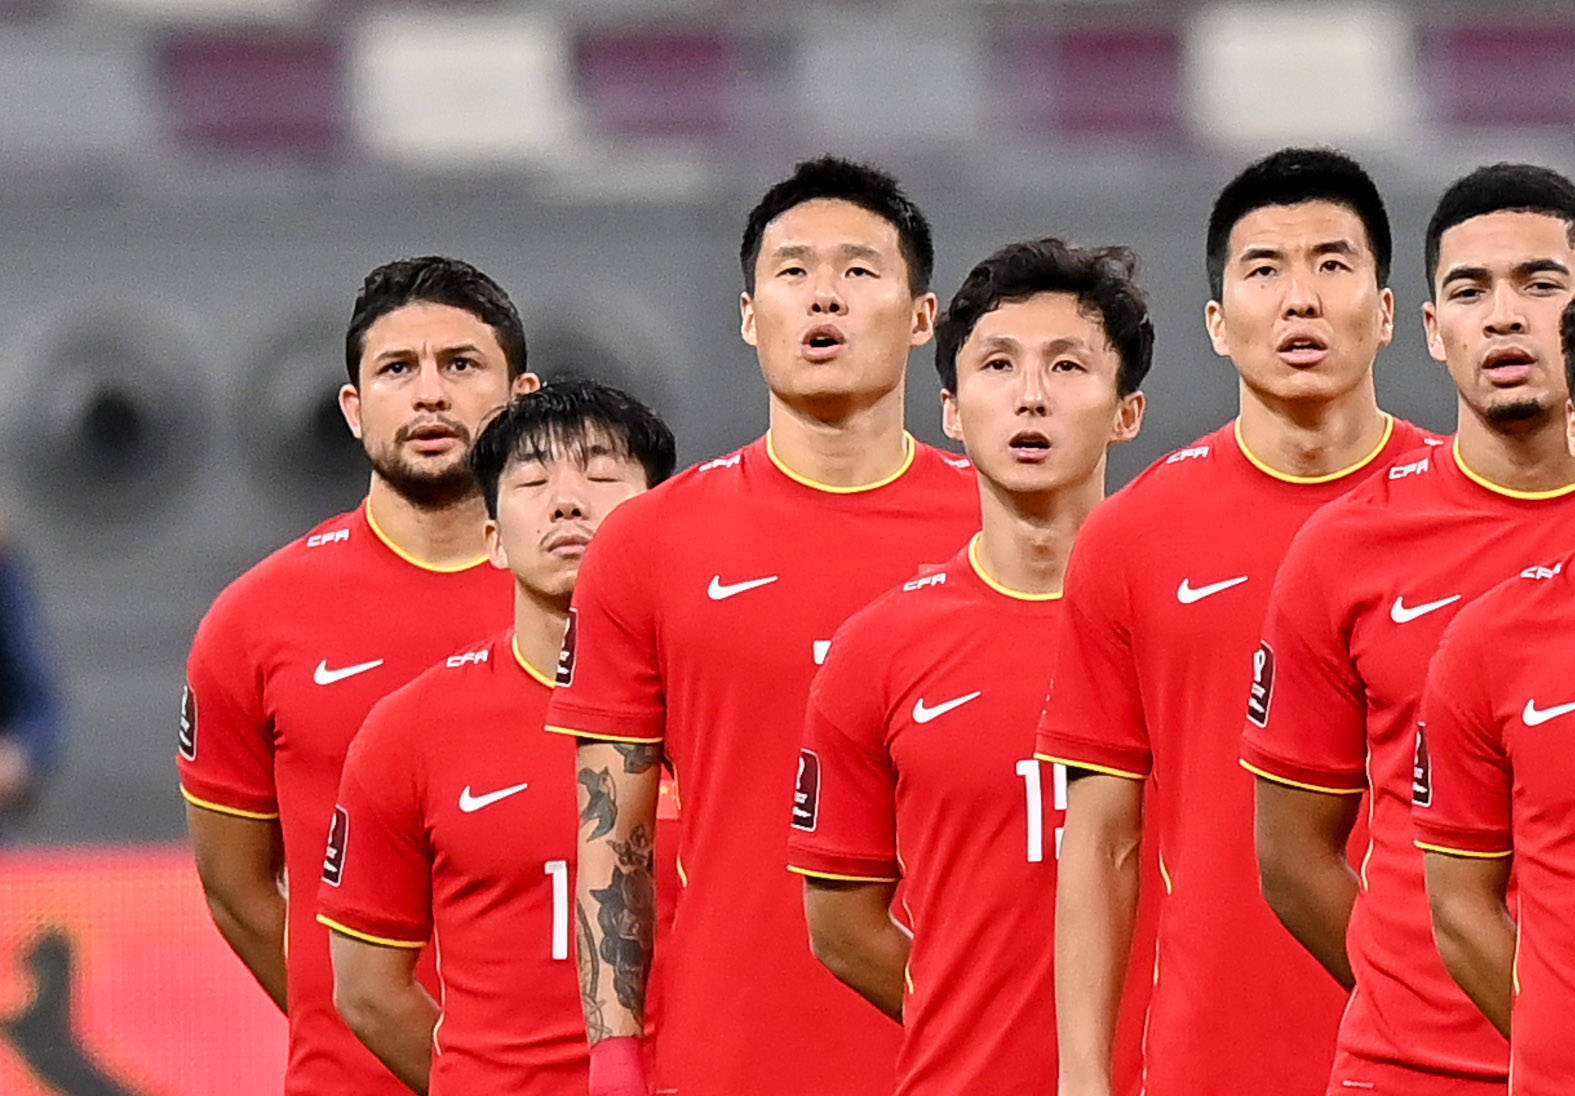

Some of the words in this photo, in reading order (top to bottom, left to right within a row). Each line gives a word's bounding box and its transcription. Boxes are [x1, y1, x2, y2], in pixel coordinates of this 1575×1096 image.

[1165, 446, 1209, 464] CFA
[1388, 458, 1429, 480] CFA
[307, 529, 350, 547] CFA
[903, 572, 947, 592] CFA
[446, 649, 489, 668] CFA
